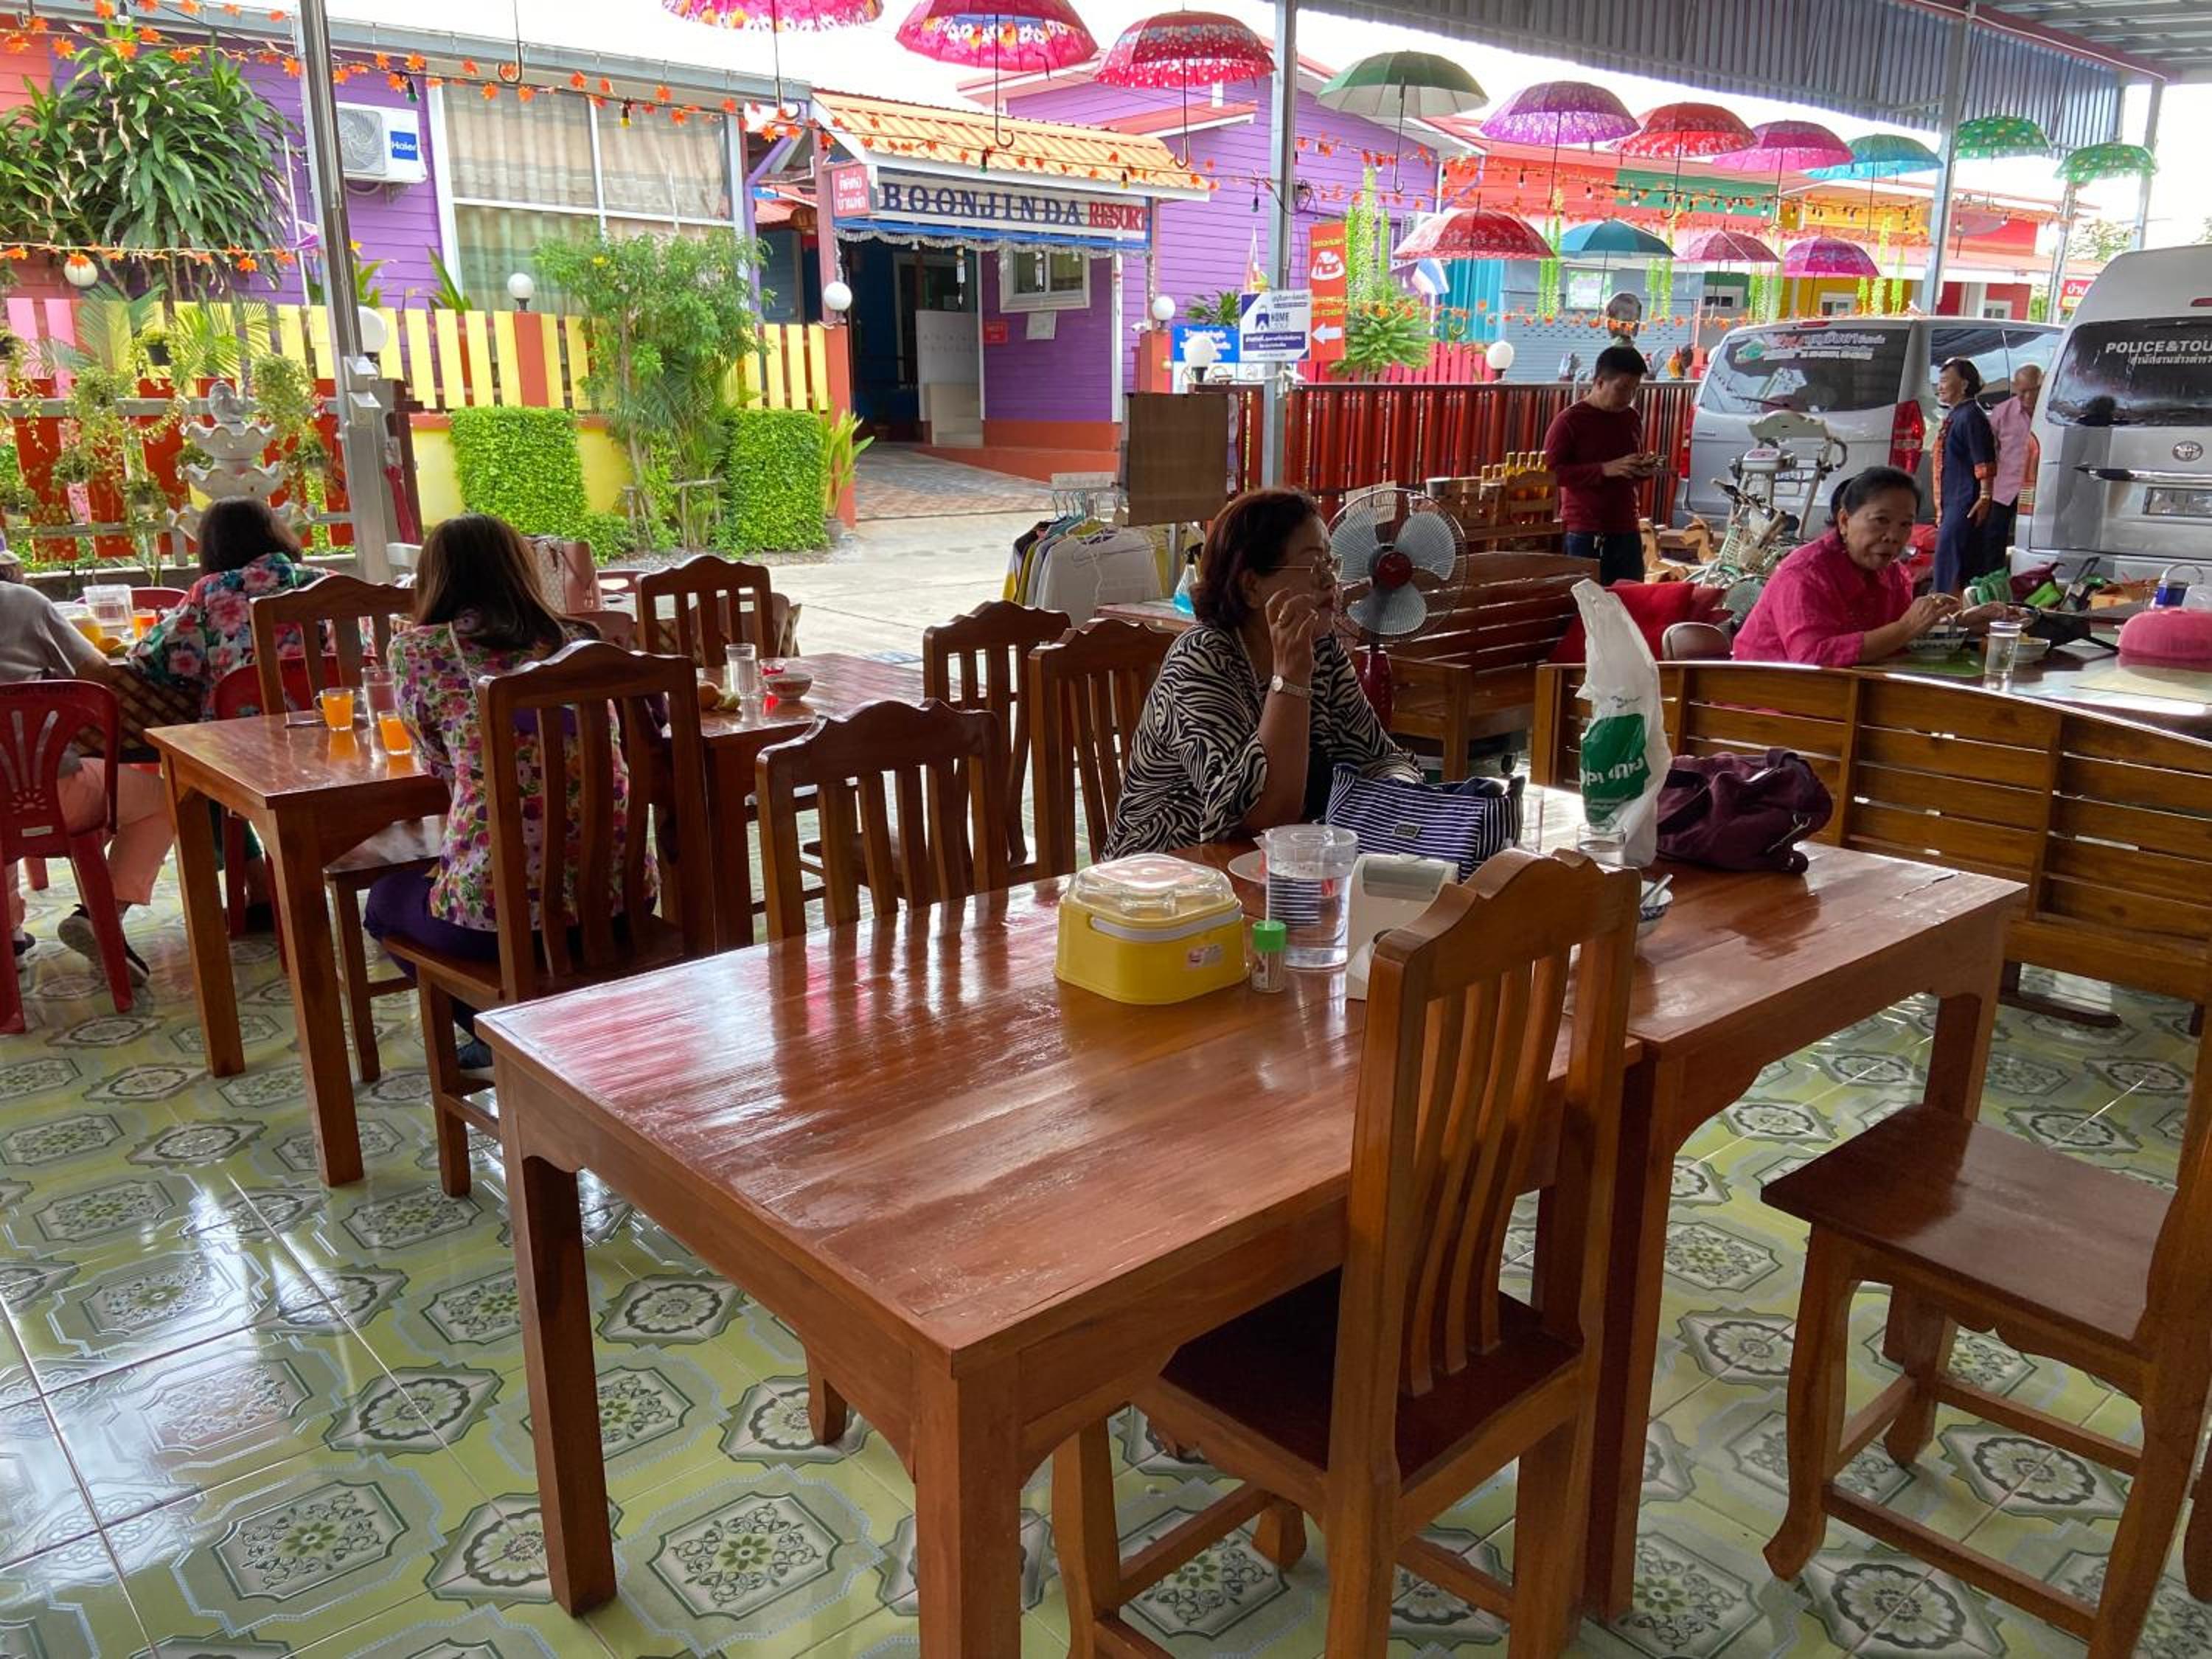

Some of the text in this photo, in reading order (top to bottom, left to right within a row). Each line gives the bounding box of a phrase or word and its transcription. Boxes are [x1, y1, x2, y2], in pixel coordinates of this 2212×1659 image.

[391, 141, 417, 151] Haier
[879, 182, 1147, 232] BOONJINDA RESORT
